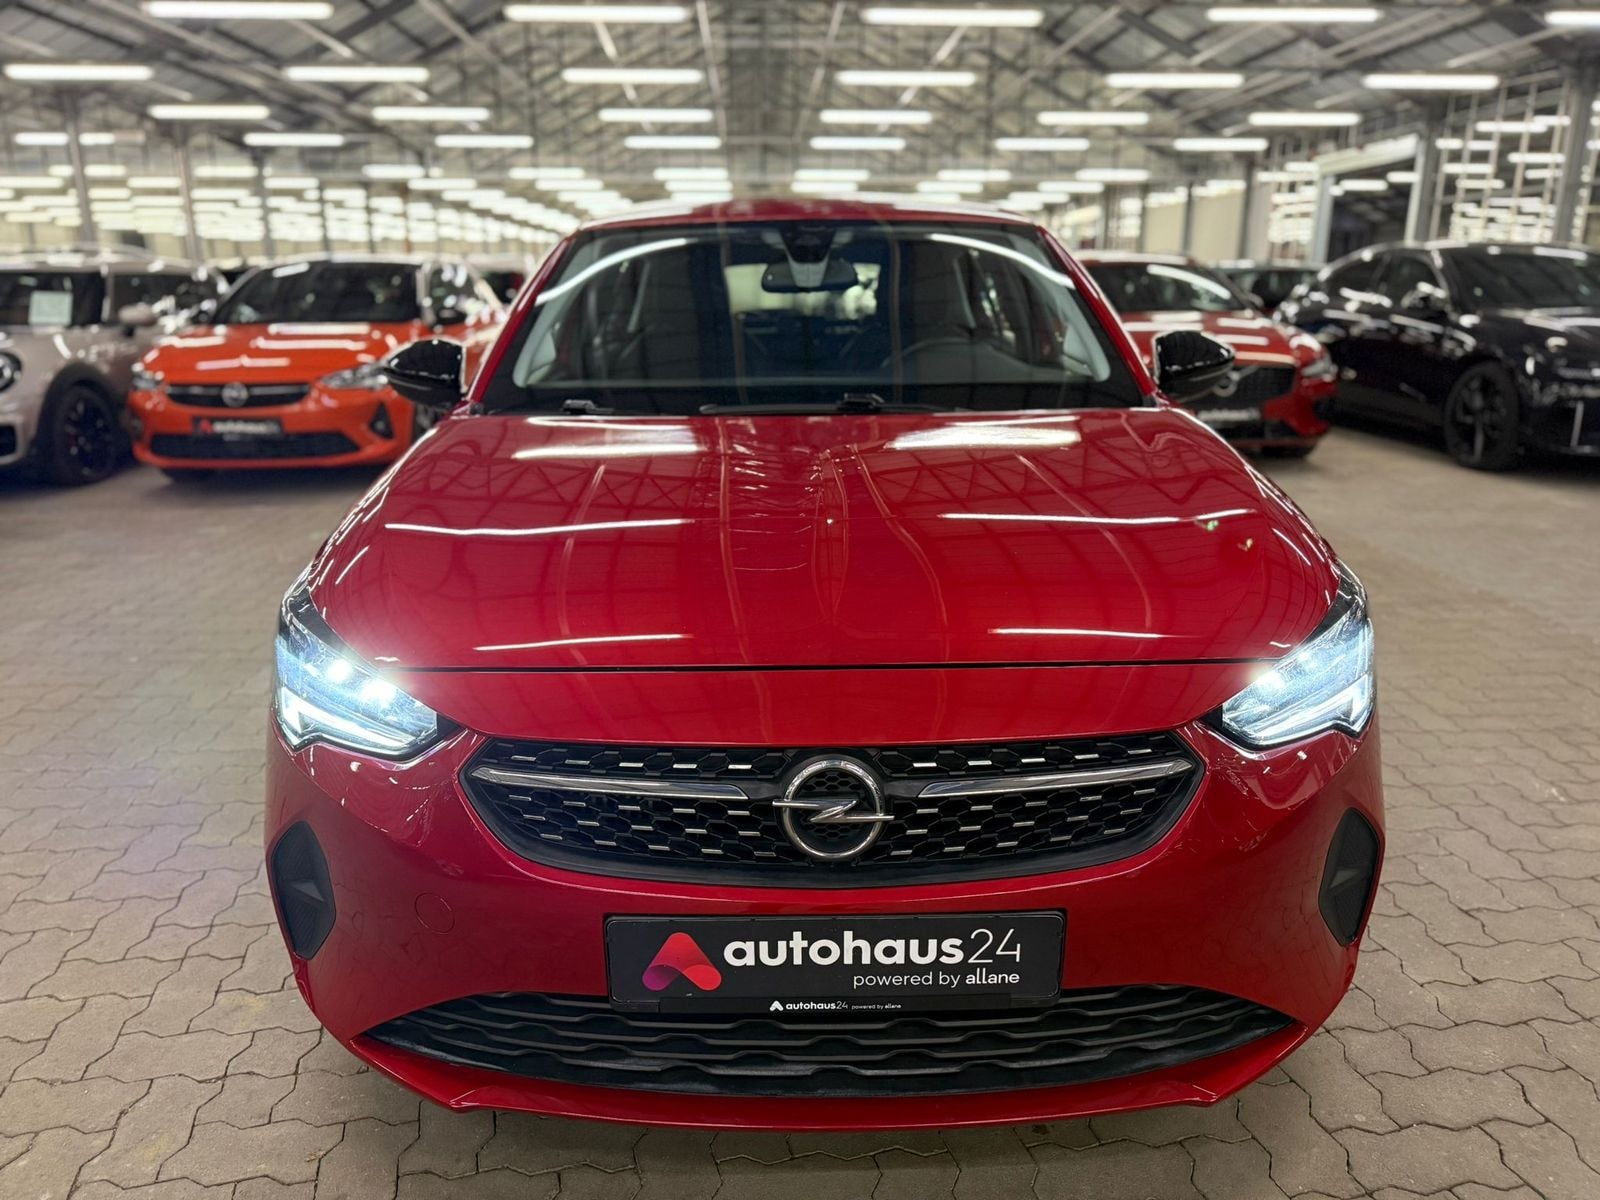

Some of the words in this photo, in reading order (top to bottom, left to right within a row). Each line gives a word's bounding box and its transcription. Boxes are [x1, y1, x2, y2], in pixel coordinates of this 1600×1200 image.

[723, 928, 1022, 967] autohaus24
[853, 971, 933, 989] powered
[938, 971, 961, 989] by
[965, 967, 1020, 985] allane
[785, 1000, 848, 1010] autohaus24
